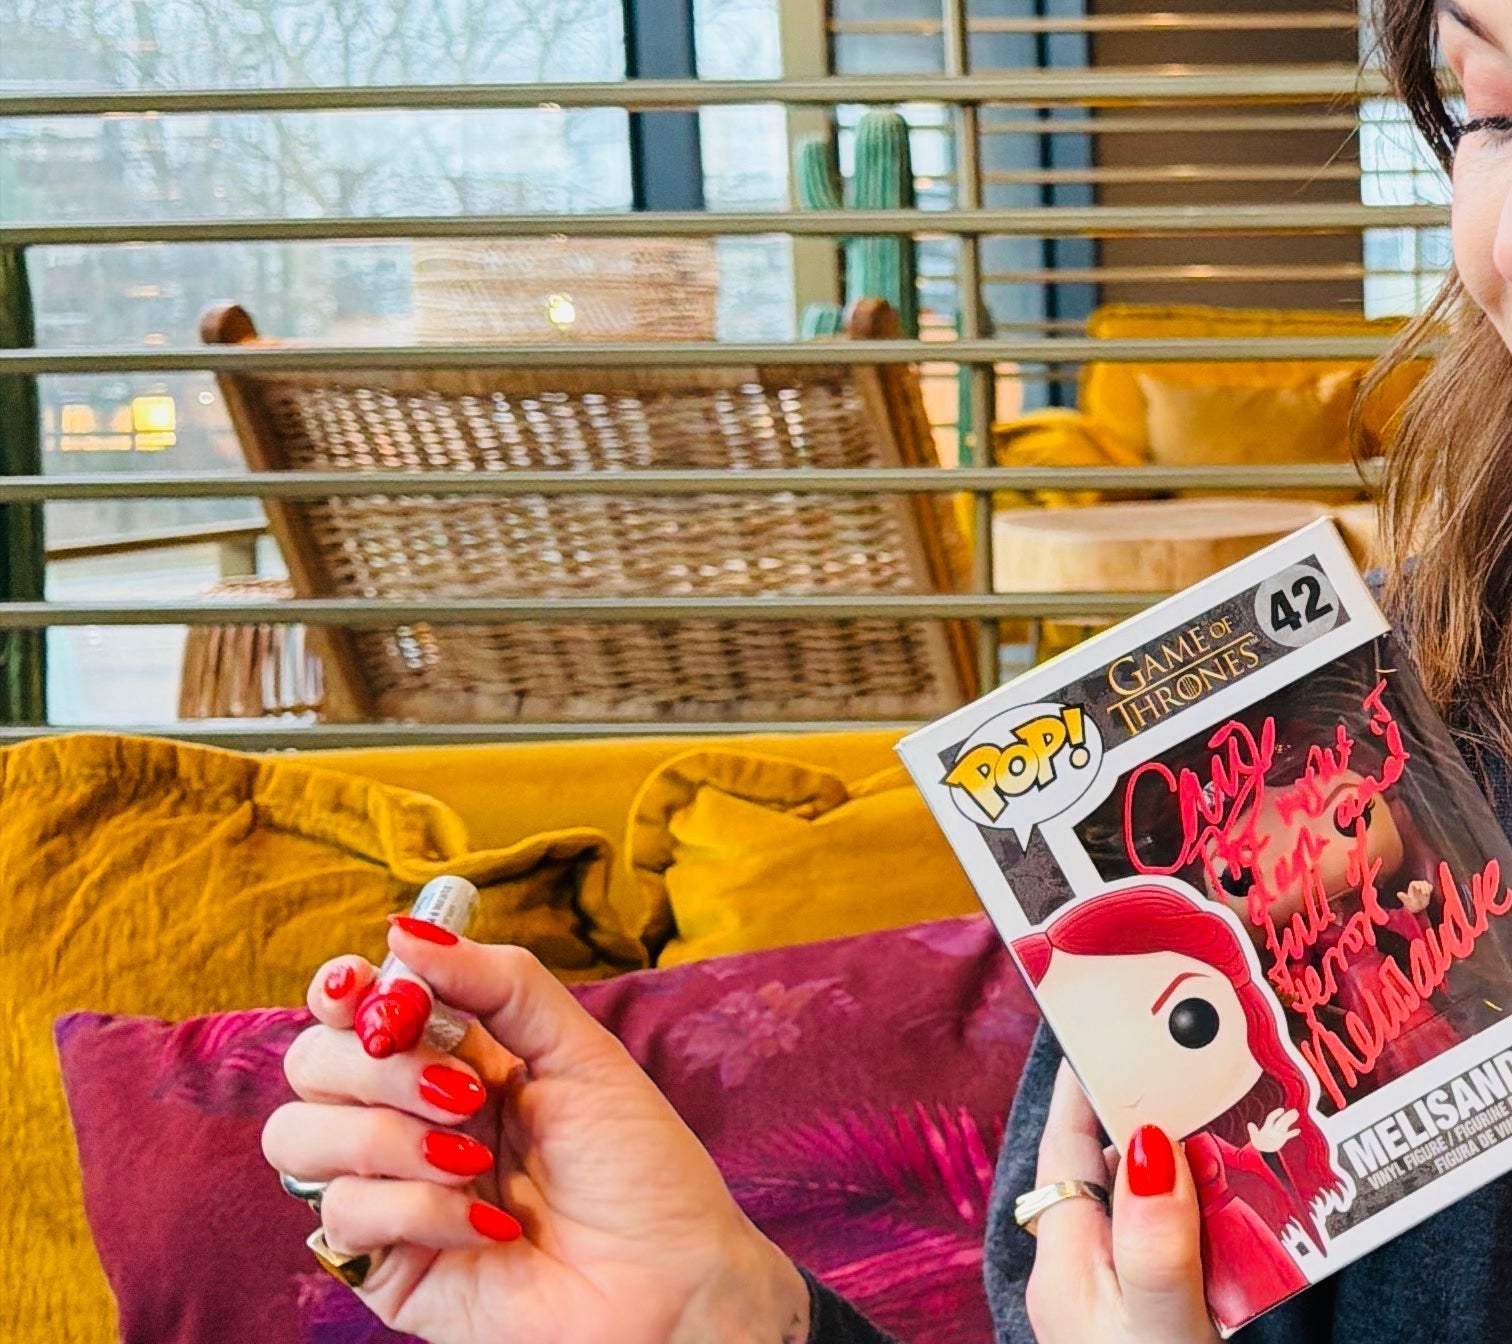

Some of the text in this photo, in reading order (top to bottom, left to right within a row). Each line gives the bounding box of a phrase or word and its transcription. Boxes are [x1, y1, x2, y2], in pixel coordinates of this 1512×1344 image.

[1269, 575, 1334, 634] 42
[1107, 639, 1259, 737] THRONES
[1108, 615, 1233, 696] GAME OF
[942, 703, 1091, 822] POP!
[1367, 1160, 1406, 1190] VINYL
[1405, 1133, 1450, 1172] FIGURE
[1455, 1105, 1507, 1139] FIGURINE
[1434, 1141, 1479, 1174] FIGURA
[1478, 1130, 1498, 1148] DE
